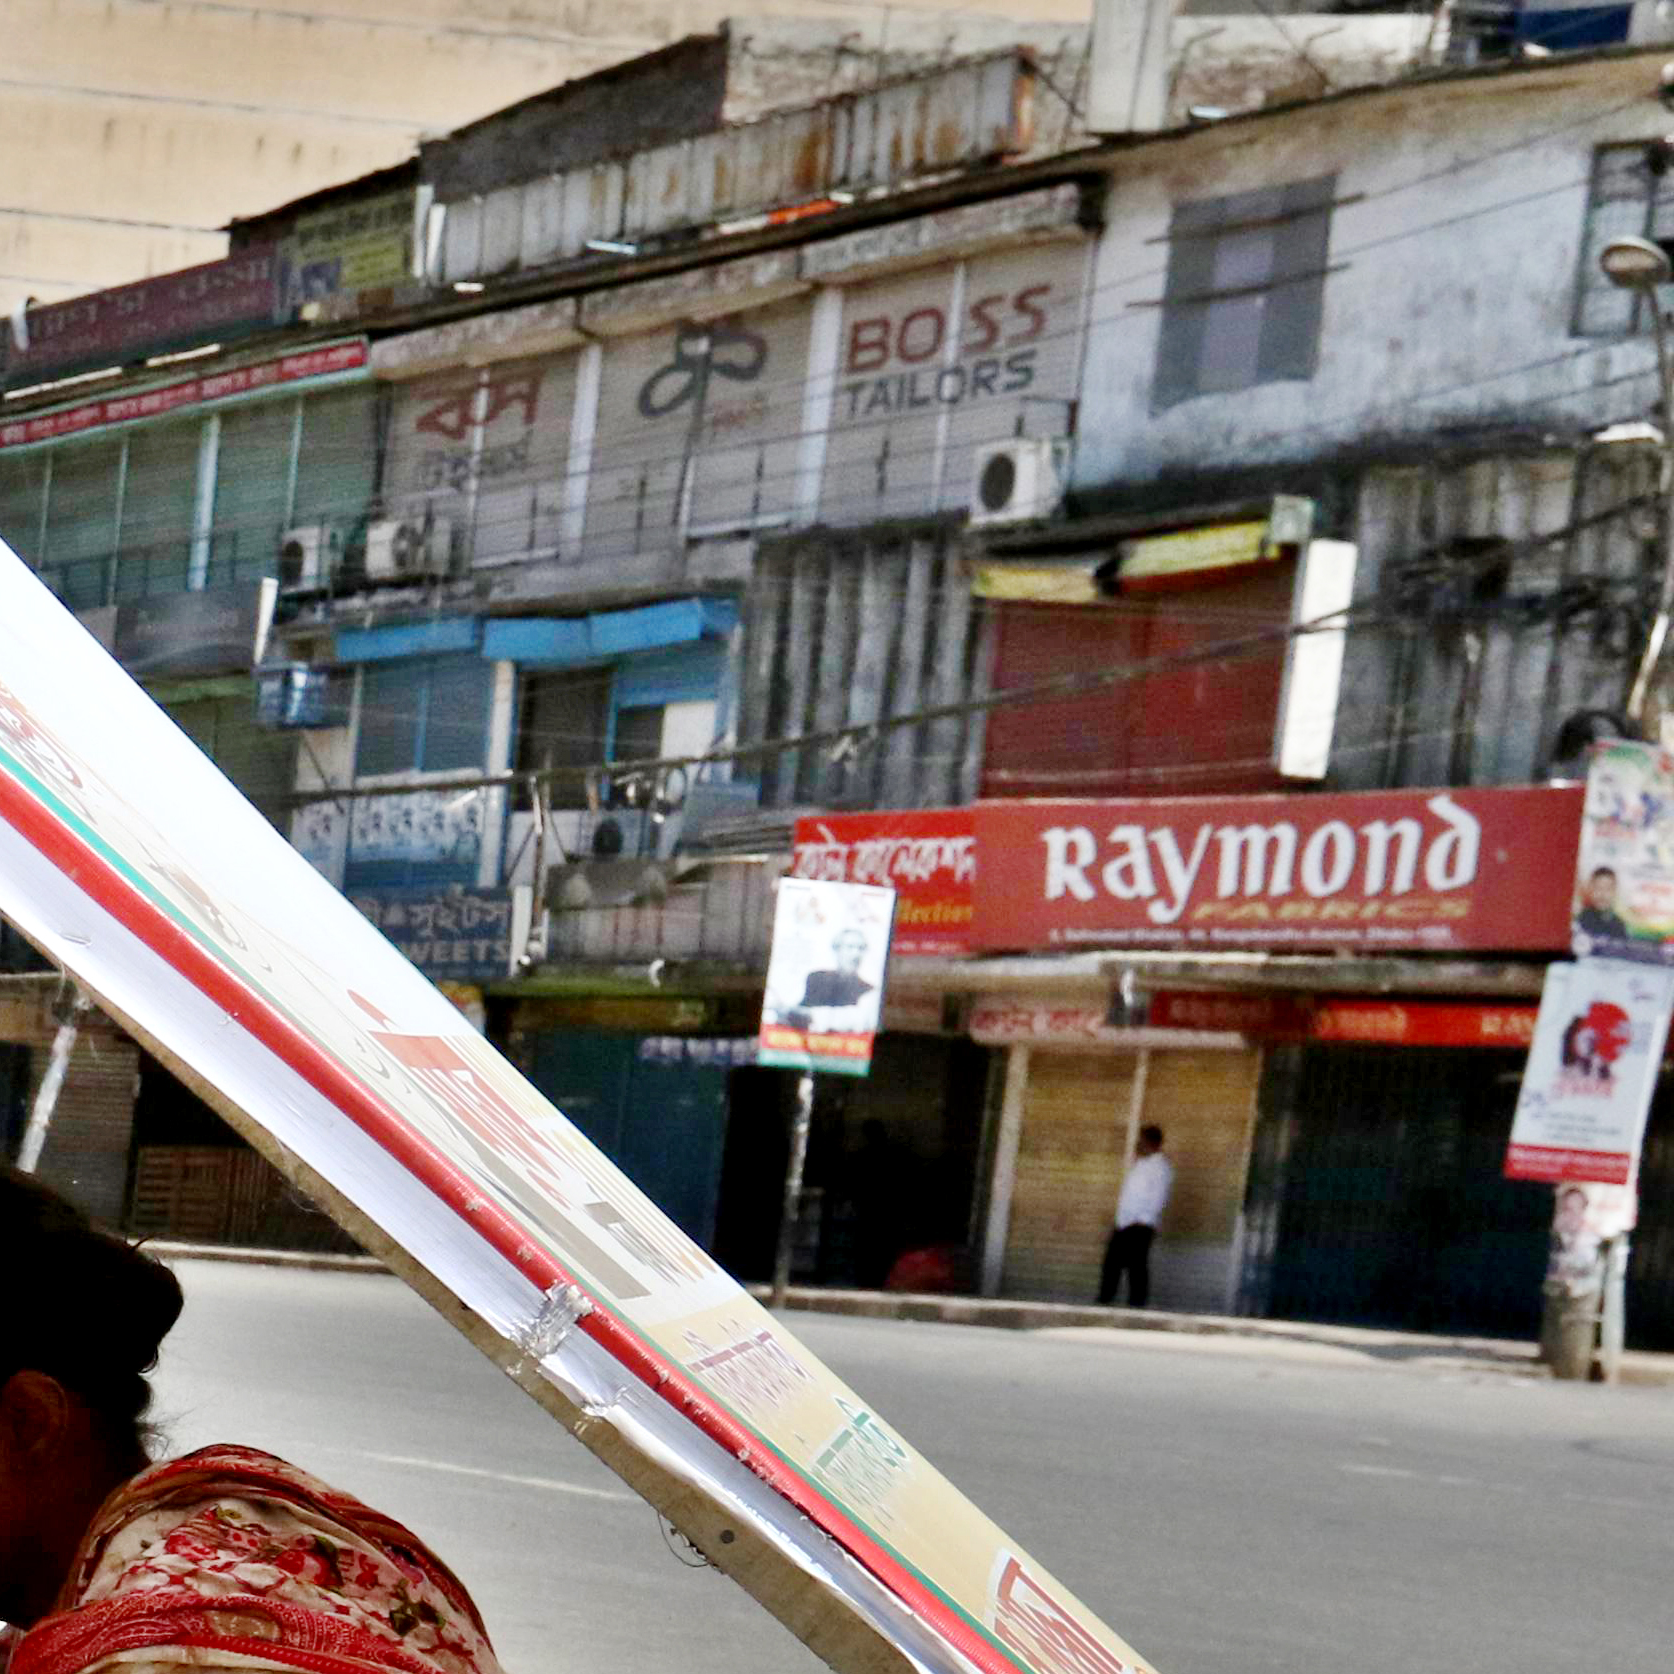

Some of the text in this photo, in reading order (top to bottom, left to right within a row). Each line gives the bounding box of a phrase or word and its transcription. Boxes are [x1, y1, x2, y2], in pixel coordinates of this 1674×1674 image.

[846, 286, 1051, 375] BOSS
[846, 350, 1037, 418] TAILORS
[1042, 794, 1482, 925] Raymond
[1191, 899, 1470, 921] FABRICS
